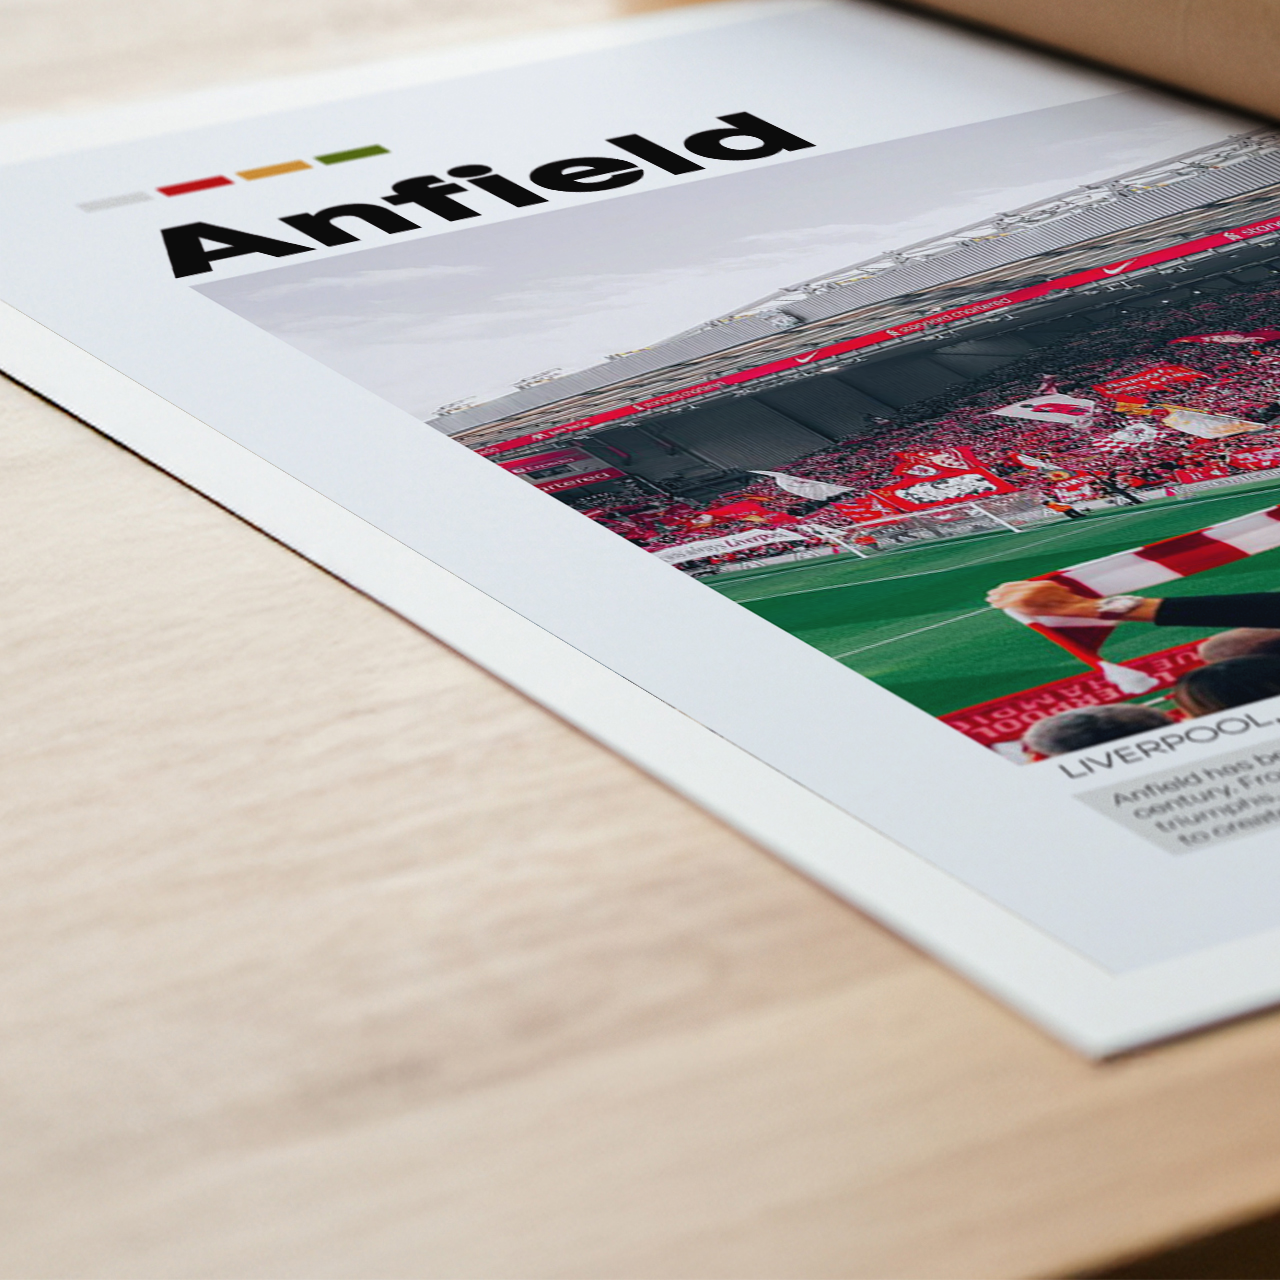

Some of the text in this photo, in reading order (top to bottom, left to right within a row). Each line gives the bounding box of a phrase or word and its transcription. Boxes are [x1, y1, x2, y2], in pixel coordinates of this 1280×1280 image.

[161, 111, 817, 279] Anfield
[971, 670, 1177, 738] LERPOOL
[1113, 771, 1204, 808] Anfield
[1202, 760, 1255, 781] has
